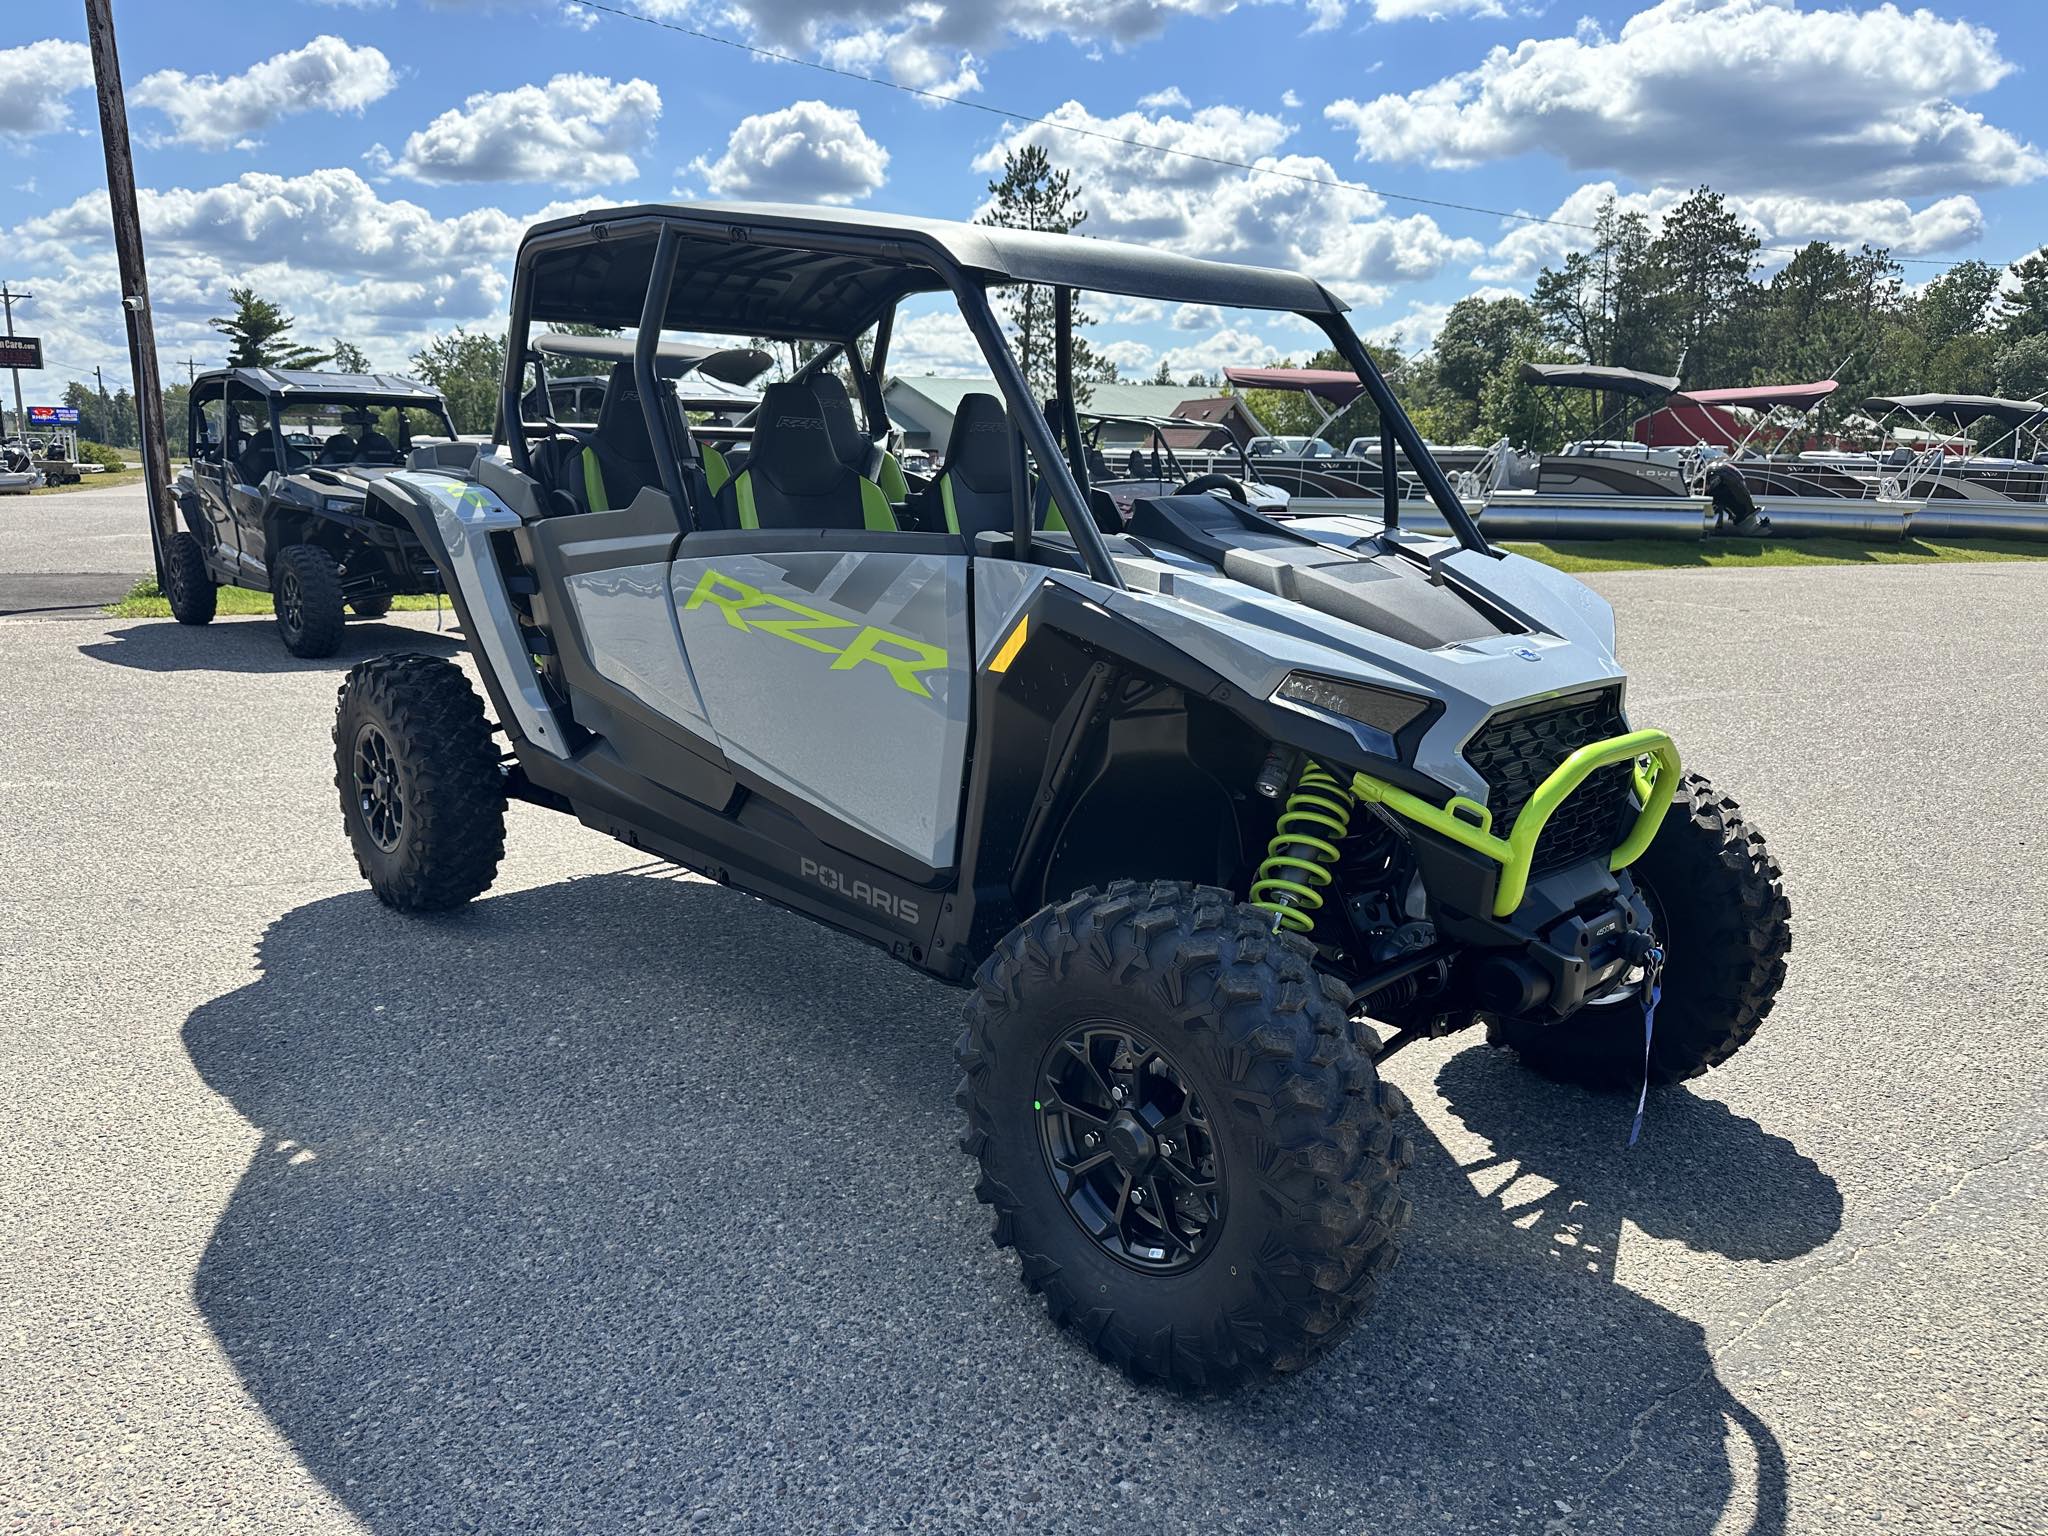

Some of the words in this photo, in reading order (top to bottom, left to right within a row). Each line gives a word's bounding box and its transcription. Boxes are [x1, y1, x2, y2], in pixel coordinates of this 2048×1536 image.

[775, 415, 826, 430] RZR
[1636, 469, 1679, 477] LOWE
[682, 568, 948, 700] RZR
[800, 856, 920, 925] POLARIS
